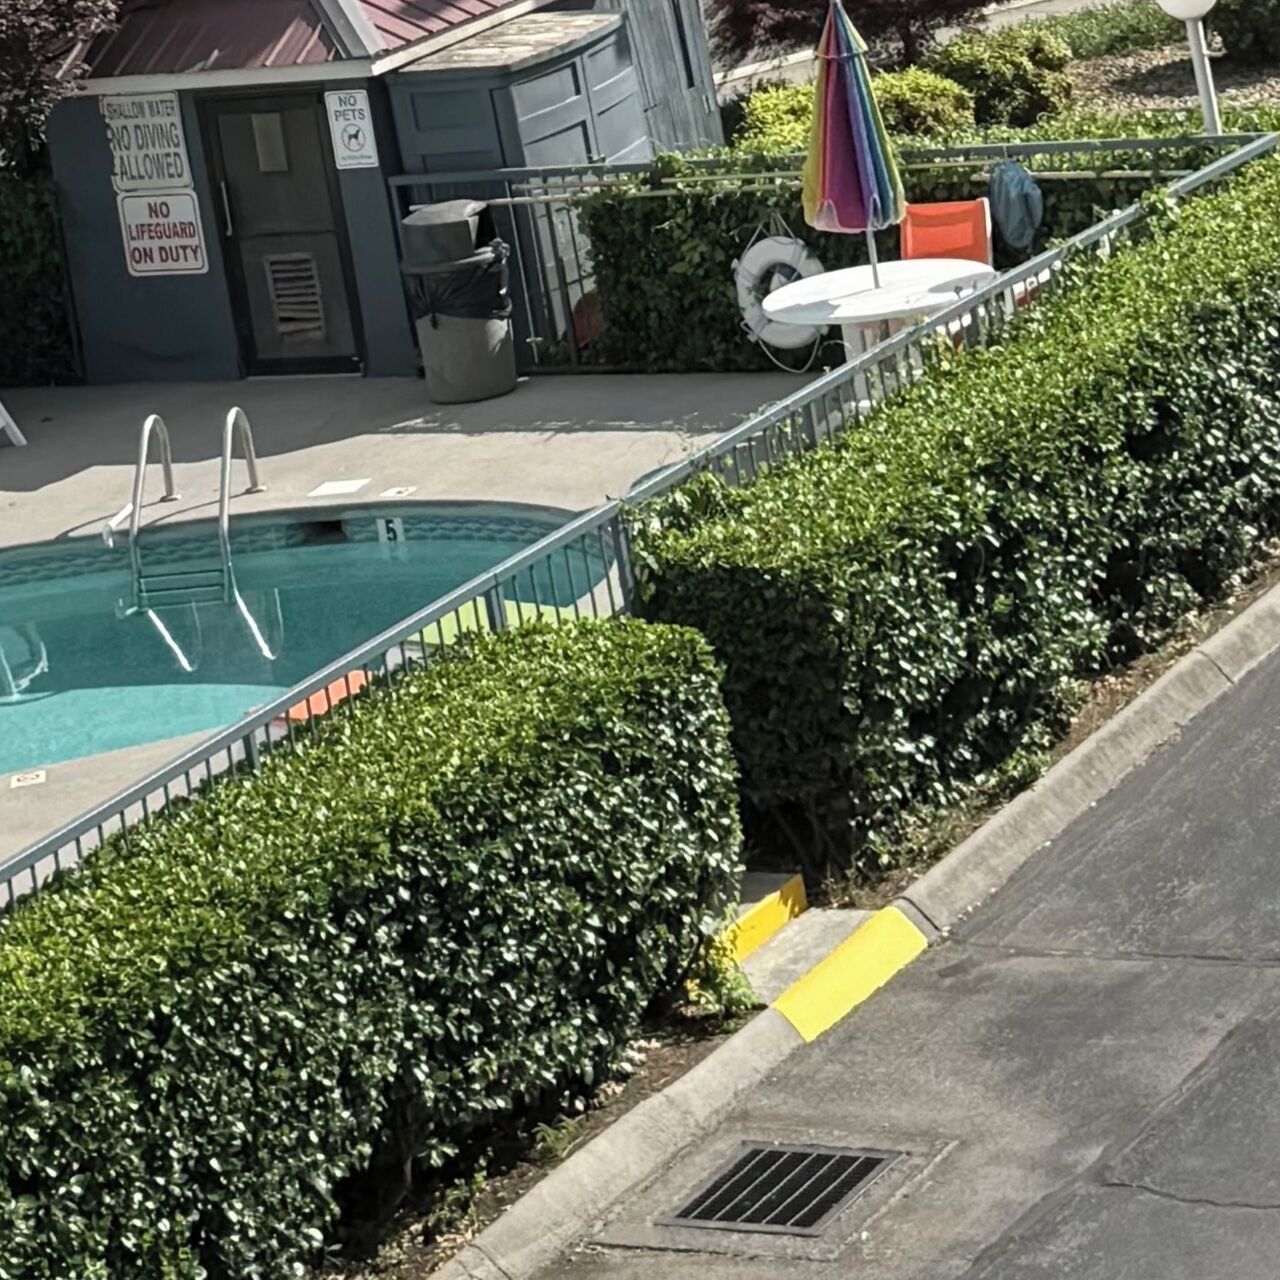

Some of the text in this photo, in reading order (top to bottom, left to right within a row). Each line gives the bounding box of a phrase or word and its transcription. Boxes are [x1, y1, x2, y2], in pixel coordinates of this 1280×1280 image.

[338, 95, 358, 108] NO
[334, 108, 366, 122] PETS
[110, 122, 181, 152] NO DIVING
[119, 151, 184, 182] ALLOWED
[147, 201, 171, 219] NO
[128, 221, 197, 241] LIFEGUARD
[131, 244, 201, 264] ON DUTY
[384, 519, 398, 542] 5
